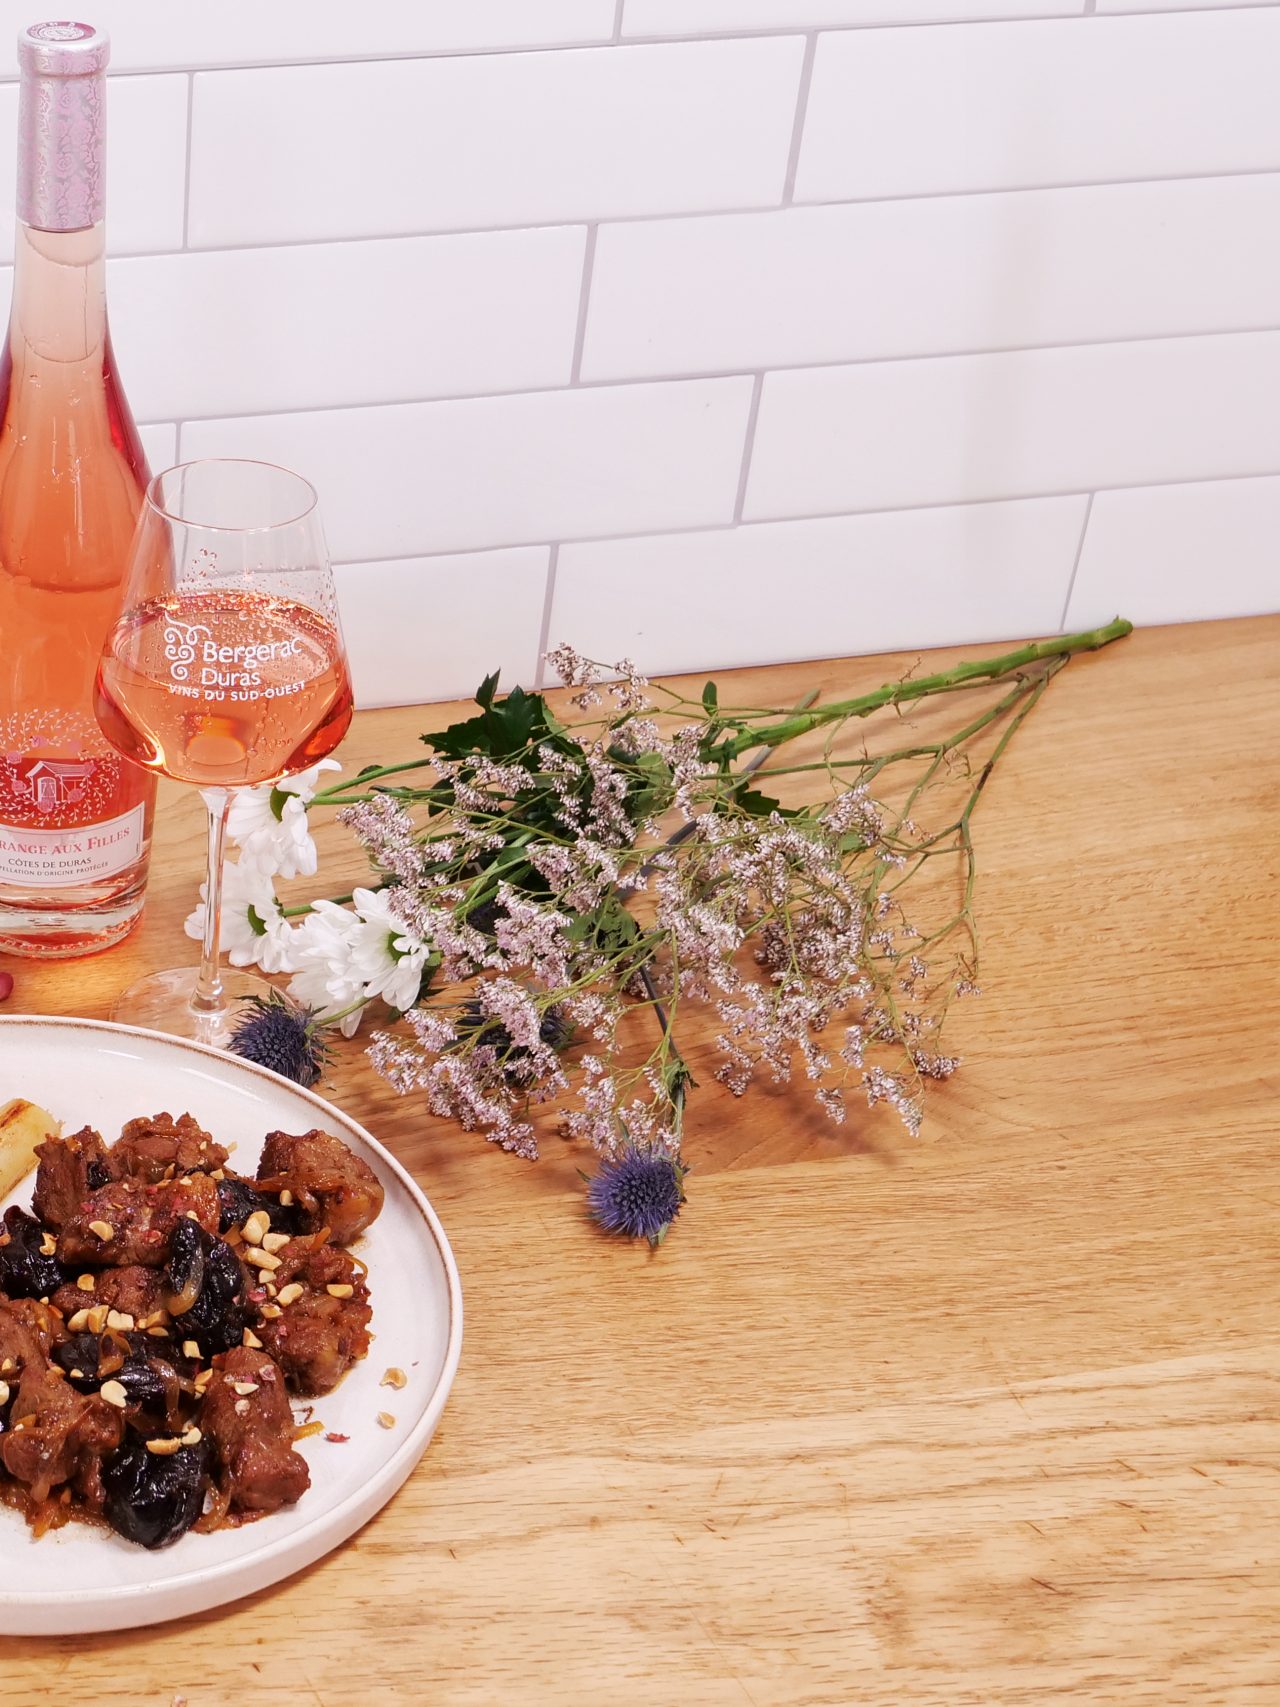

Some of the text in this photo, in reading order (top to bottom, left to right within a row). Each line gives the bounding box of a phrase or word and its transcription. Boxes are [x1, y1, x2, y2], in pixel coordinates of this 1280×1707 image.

[203, 636, 302, 669] Bergerac
[201, 668, 261, 686] Duras
[169, 680, 306, 701] VINS DU SUD-OUEST
[51, 842, 82, 855] AUX
[87, 826, 131, 850] FILLES
[8, 856, 92, 869] CÔTES DE DURAS
